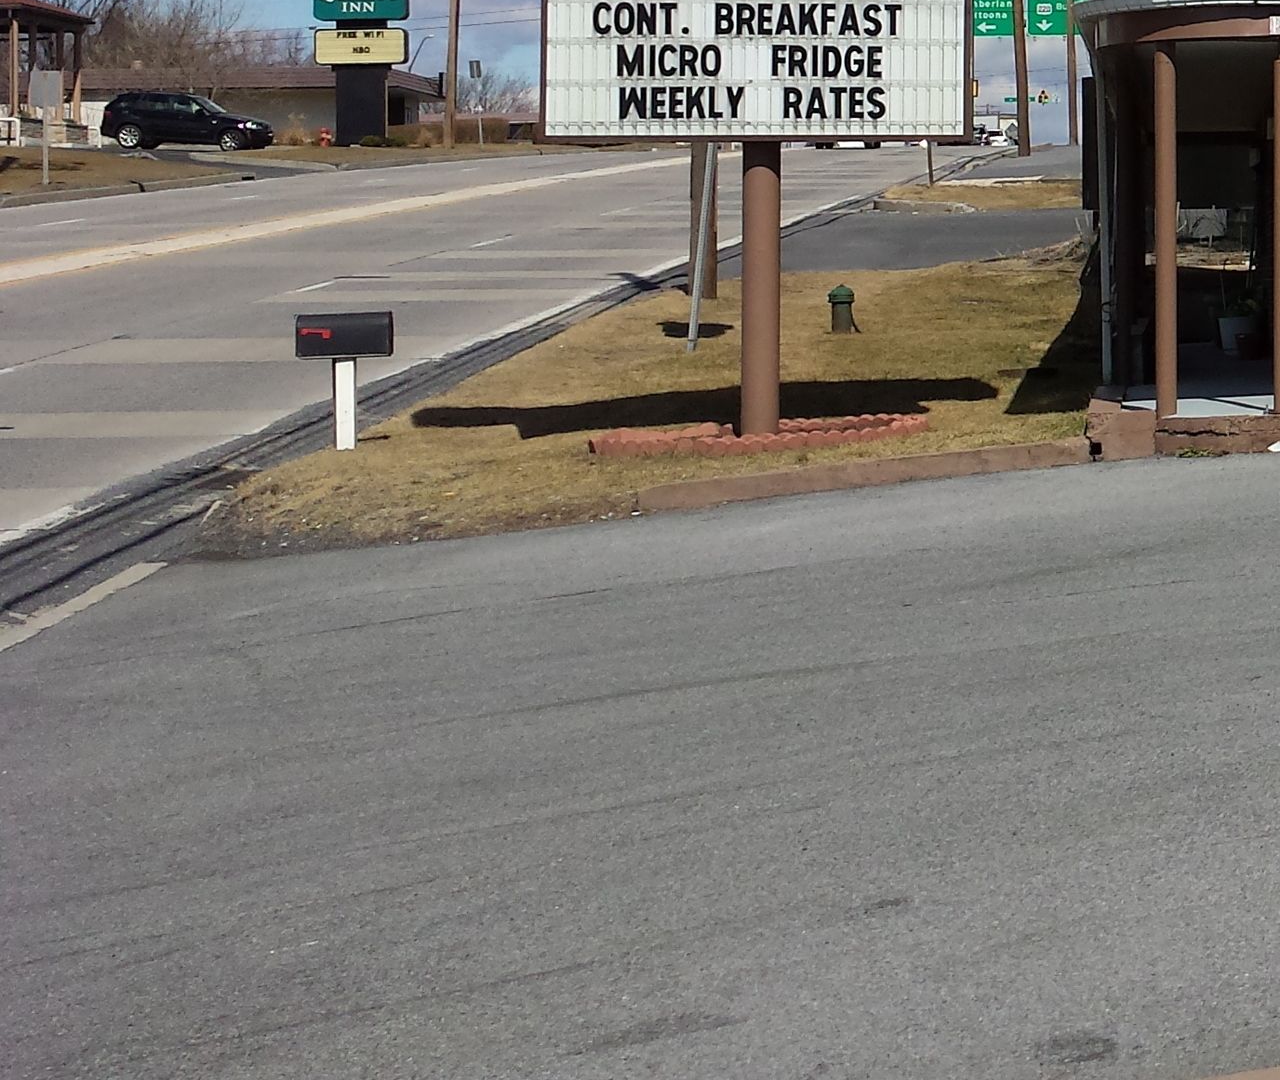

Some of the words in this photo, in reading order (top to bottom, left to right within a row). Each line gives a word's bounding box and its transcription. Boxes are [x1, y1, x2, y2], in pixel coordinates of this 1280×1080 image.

[341, 1, 375, 12] INN
[592, 2, 690, 38] CONT.
[714, 2, 902, 38] BREAKFAST
[336, 31, 358, 39] FREE
[352, 46, 371, 54] HBO
[616, 45, 722, 79] MICRO
[771, 45, 883, 79] FRIDGE
[619, 86, 746, 121] WEEKLY
[783, 86, 886, 121] RATES
